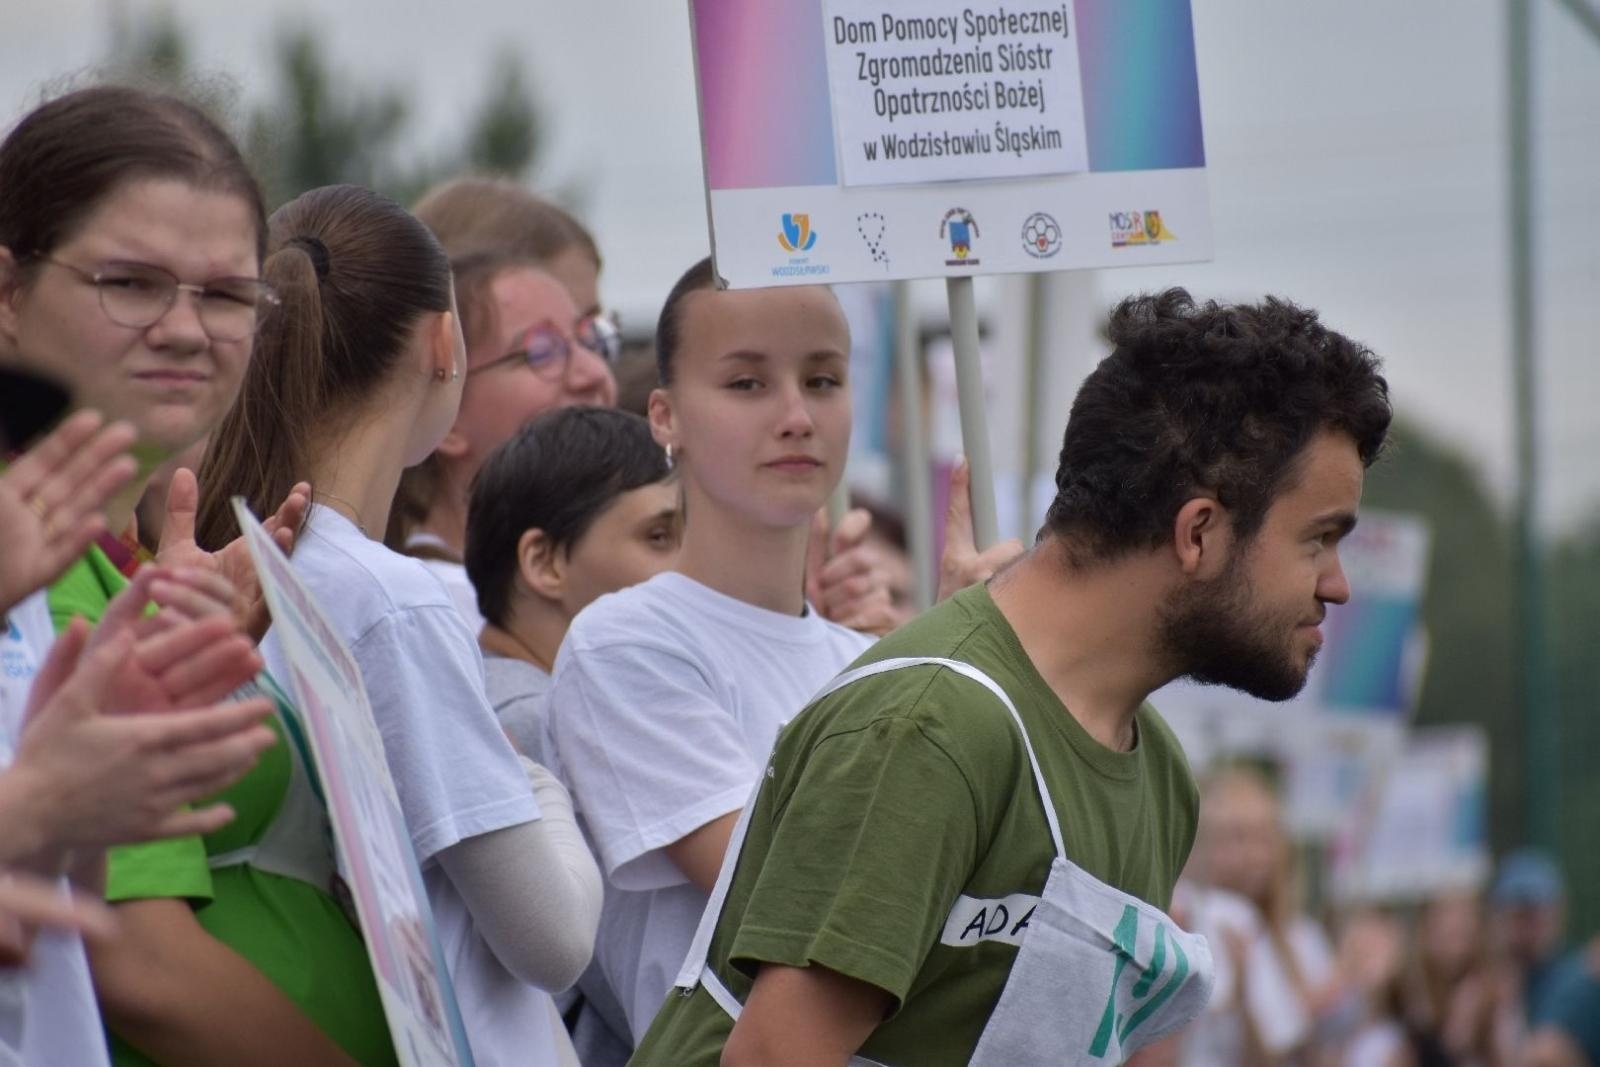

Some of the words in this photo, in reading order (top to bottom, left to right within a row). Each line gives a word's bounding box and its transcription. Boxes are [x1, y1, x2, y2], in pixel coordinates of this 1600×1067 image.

[834, 16, 877, 45] Dom
[881, 13, 958, 45] Pomocy
[963, 4, 1069, 39] Społecznej
[856, 47, 993, 86] Zgromadzenia
[999, 42, 1053, 72] Sióstr
[874, 82, 990, 122] Opatrzności
[994, 79, 1046, 113] Bożej
[863, 141, 877, 161] w
[881, 128, 991, 161] Wodzisławiu
[995, 121, 1062, 157] Śląskim
